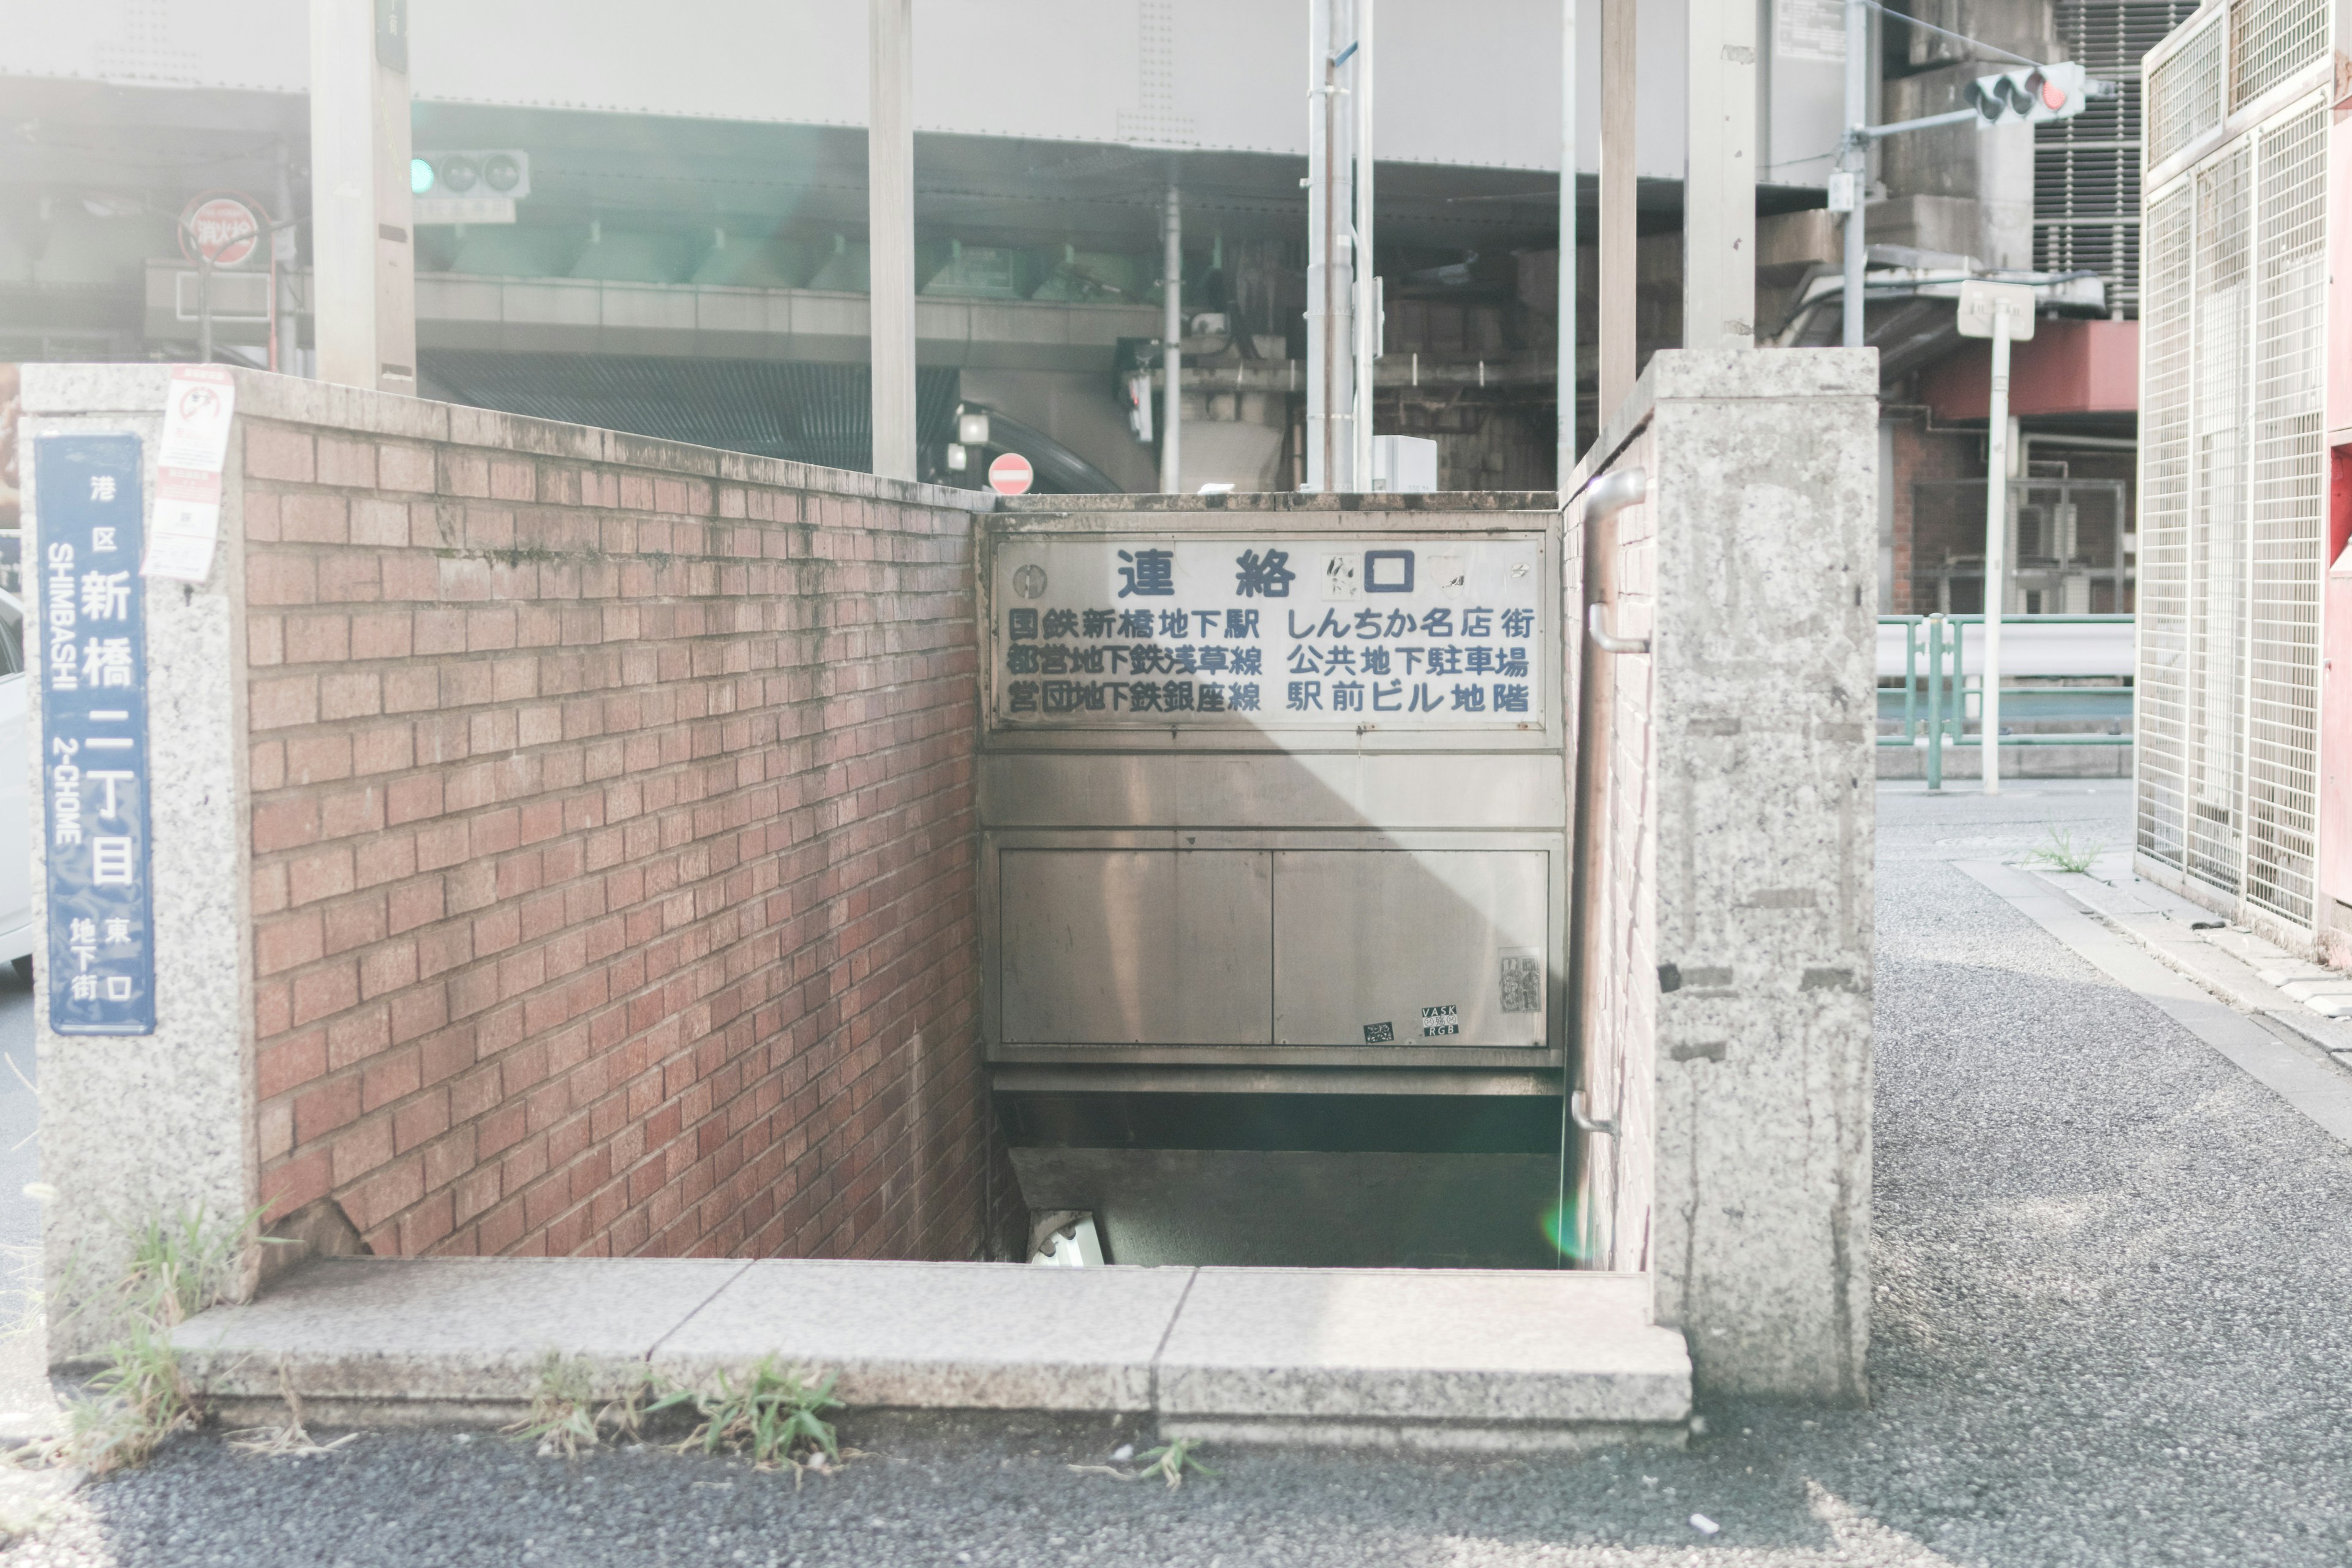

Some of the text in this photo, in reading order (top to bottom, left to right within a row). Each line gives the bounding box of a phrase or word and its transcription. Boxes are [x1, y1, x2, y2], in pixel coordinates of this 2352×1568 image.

[90, 475, 117, 552] 港区
[1117, 548, 1415, 598] 連絡口
[48, 543, 78, 690] SHIMBASHI
[1009, 608, 1260, 640] 国鉄新橋地下駅
[1287, 606, 1536, 639] しんちか名店街
[1006, 643, 1263, 676] 都営地下鉄浅草線
[1287, 644, 1529, 677] 公共地下駐車場
[1008, 679, 1262, 713] 営団地下鉄銀座線
[1286, 677, 1529, 713] 駅前ビル地階
[81, 570, 134, 887] 新橋二丁目
[53, 737, 82, 845] 2-CHOME
[70, 918, 97, 1001] 地下街
[105, 918, 132, 1001] 東口
[1422, 1006, 1455, 1017] VASK
[1429, 1025, 1454, 1036] RGB
